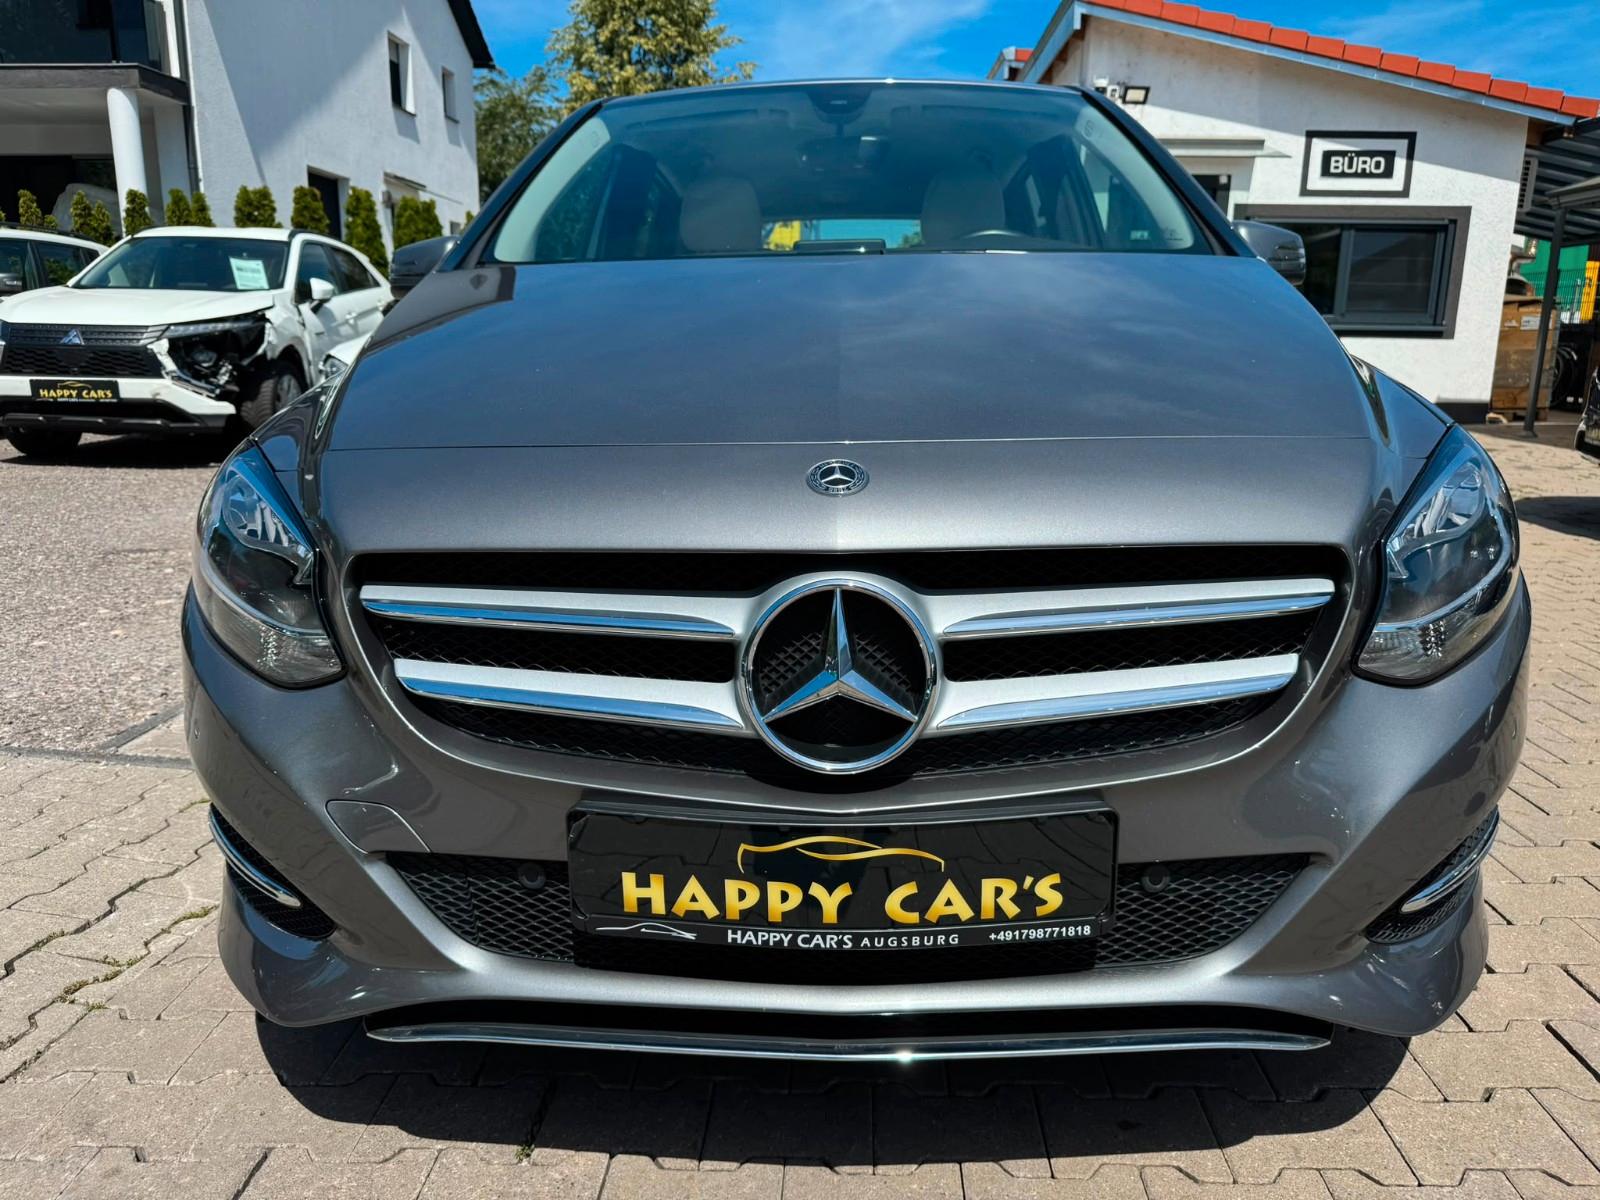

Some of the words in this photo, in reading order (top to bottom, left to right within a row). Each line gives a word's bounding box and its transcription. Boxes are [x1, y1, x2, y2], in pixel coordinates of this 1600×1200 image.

[1329, 152, 1386, 174] BÜRO
[39, 388, 78, 398] HAPPY
[621, 871, 853, 924] HAPPY
[884, 872, 1064, 924] CAR'S
[727, 929, 792, 947] HAPPY
[796, 932, 853, 949] CAR'S
[860, 933, 960, 948] AUGSBURG
[988, 924, 1092, 942] +491798771818
